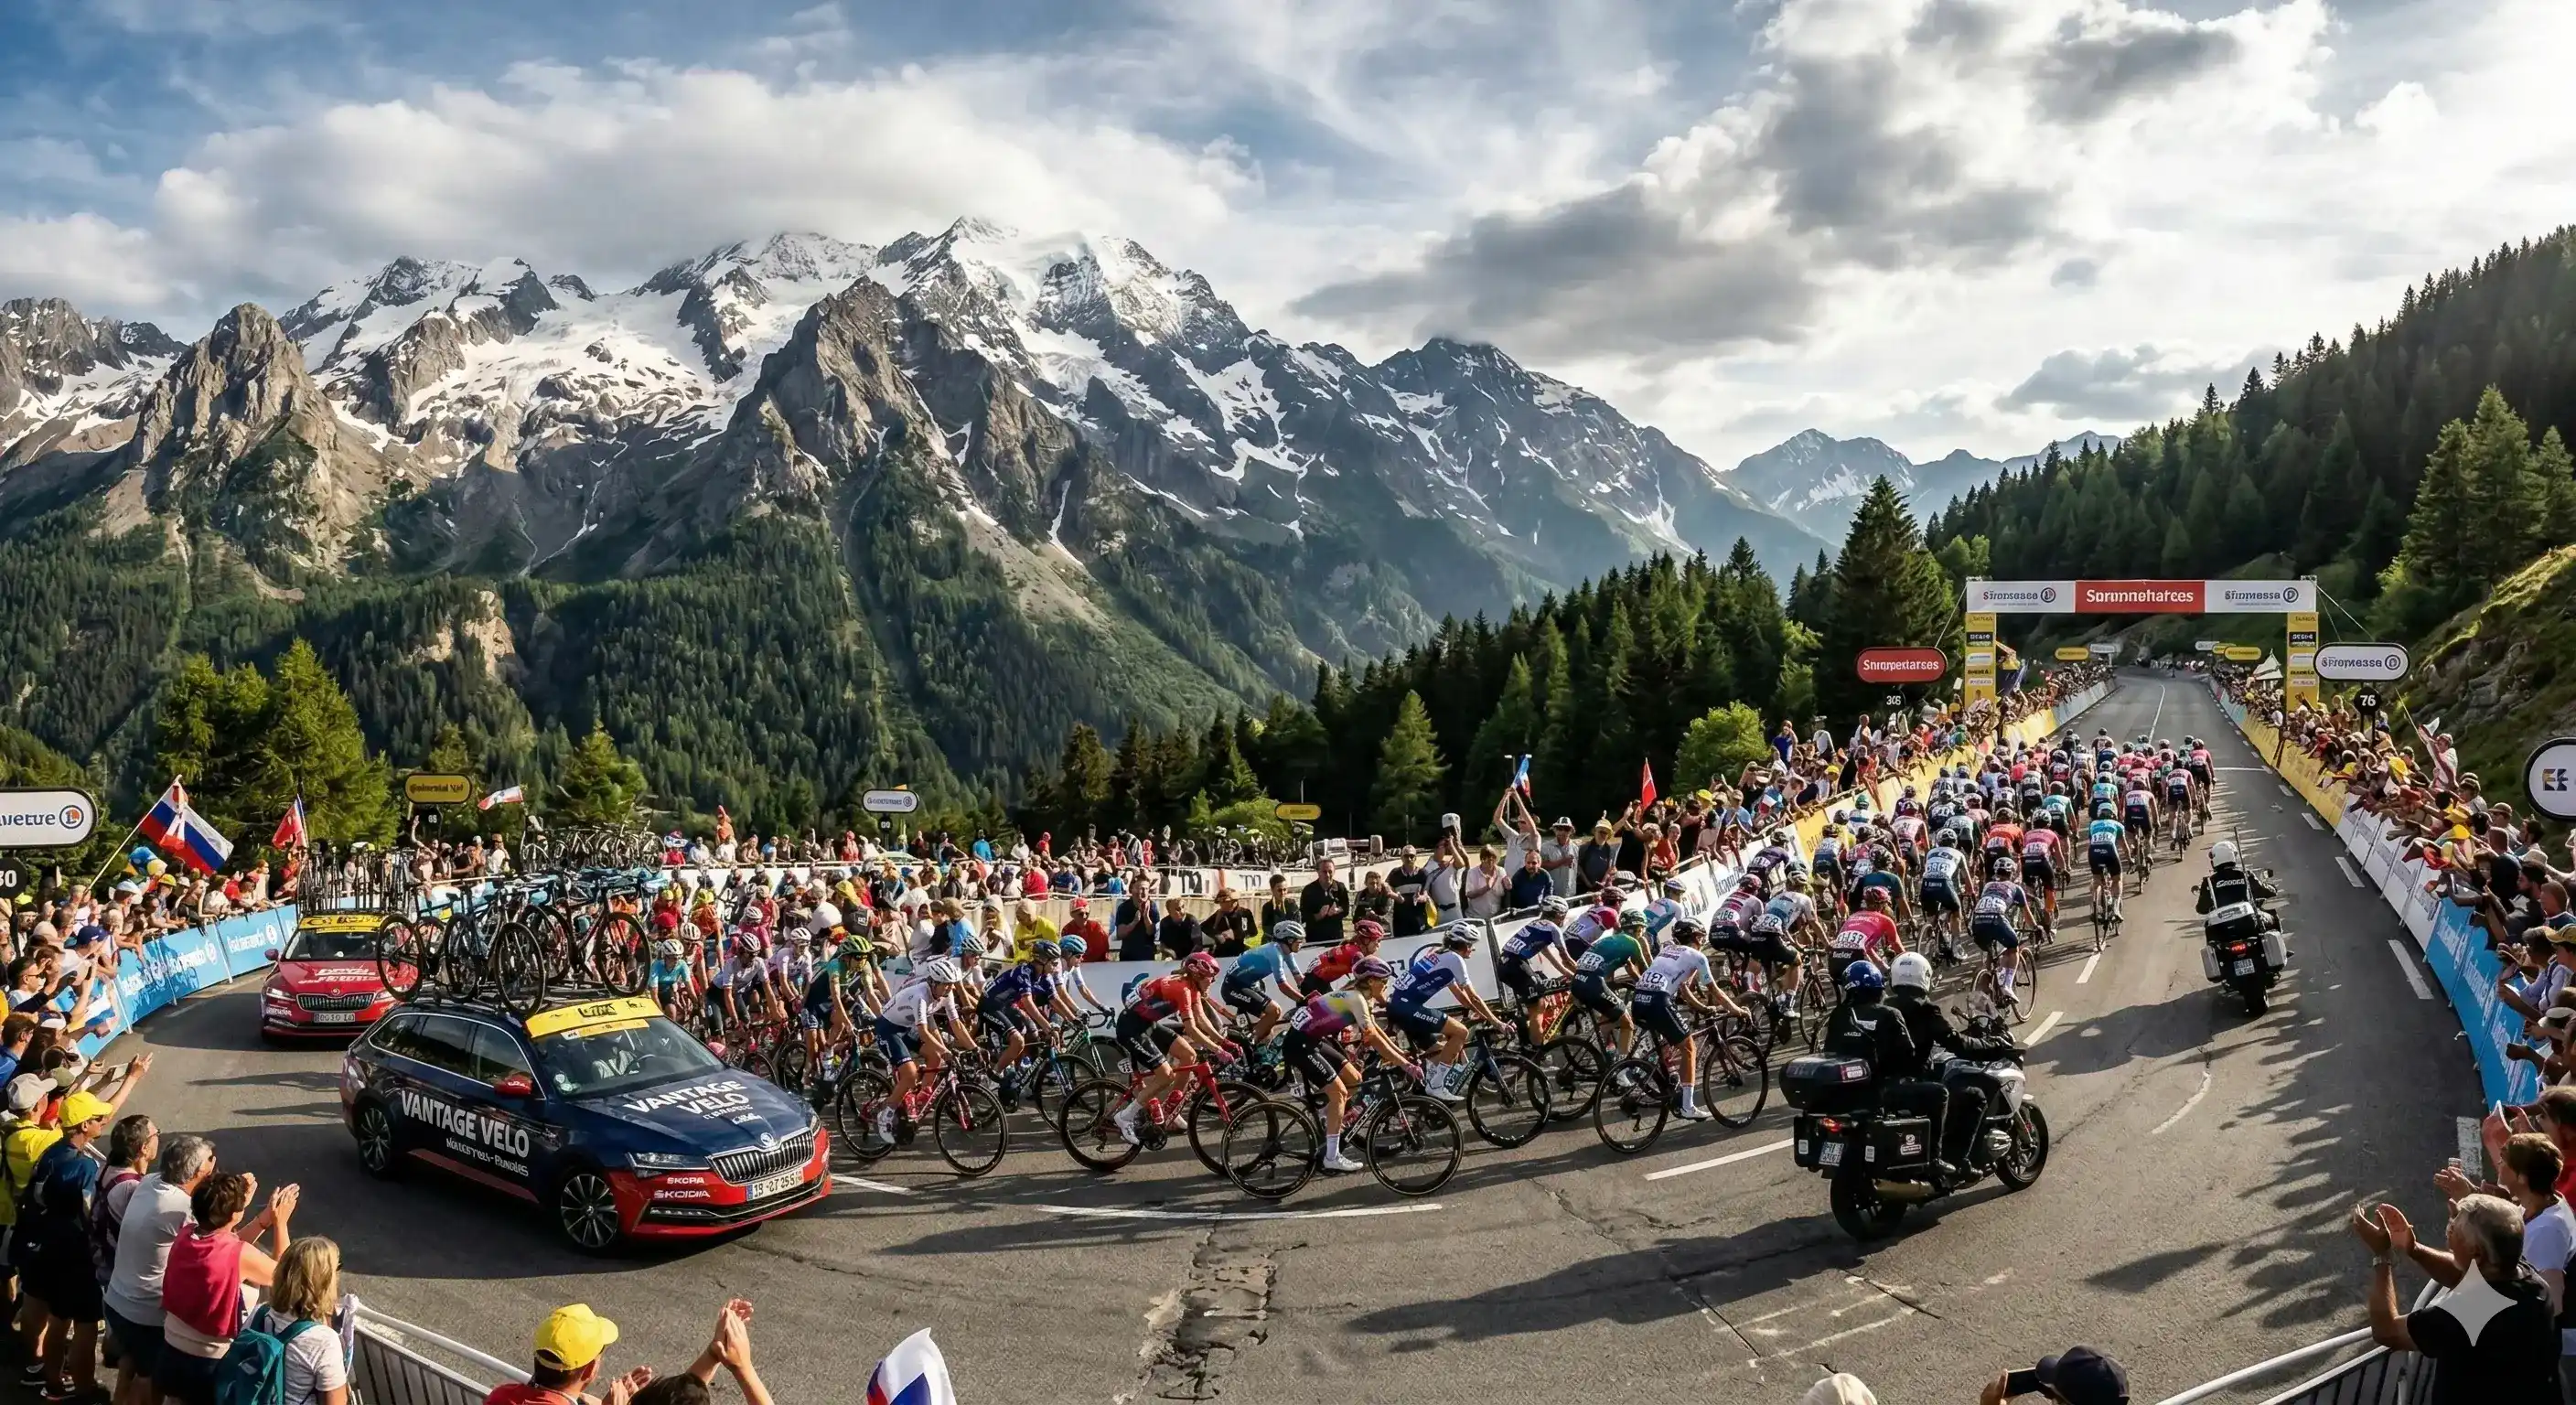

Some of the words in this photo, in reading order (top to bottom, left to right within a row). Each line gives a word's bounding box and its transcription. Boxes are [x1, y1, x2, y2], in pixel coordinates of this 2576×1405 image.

[2360, 695, 2377, 706] 76
[623, 1080, 747, 1113] VANTAGE
[677, 1093, 750, 1114] VELO
[401, 1089, 478, 1141] VANTAGE
[480, 1116, 530, 1158] VELO
